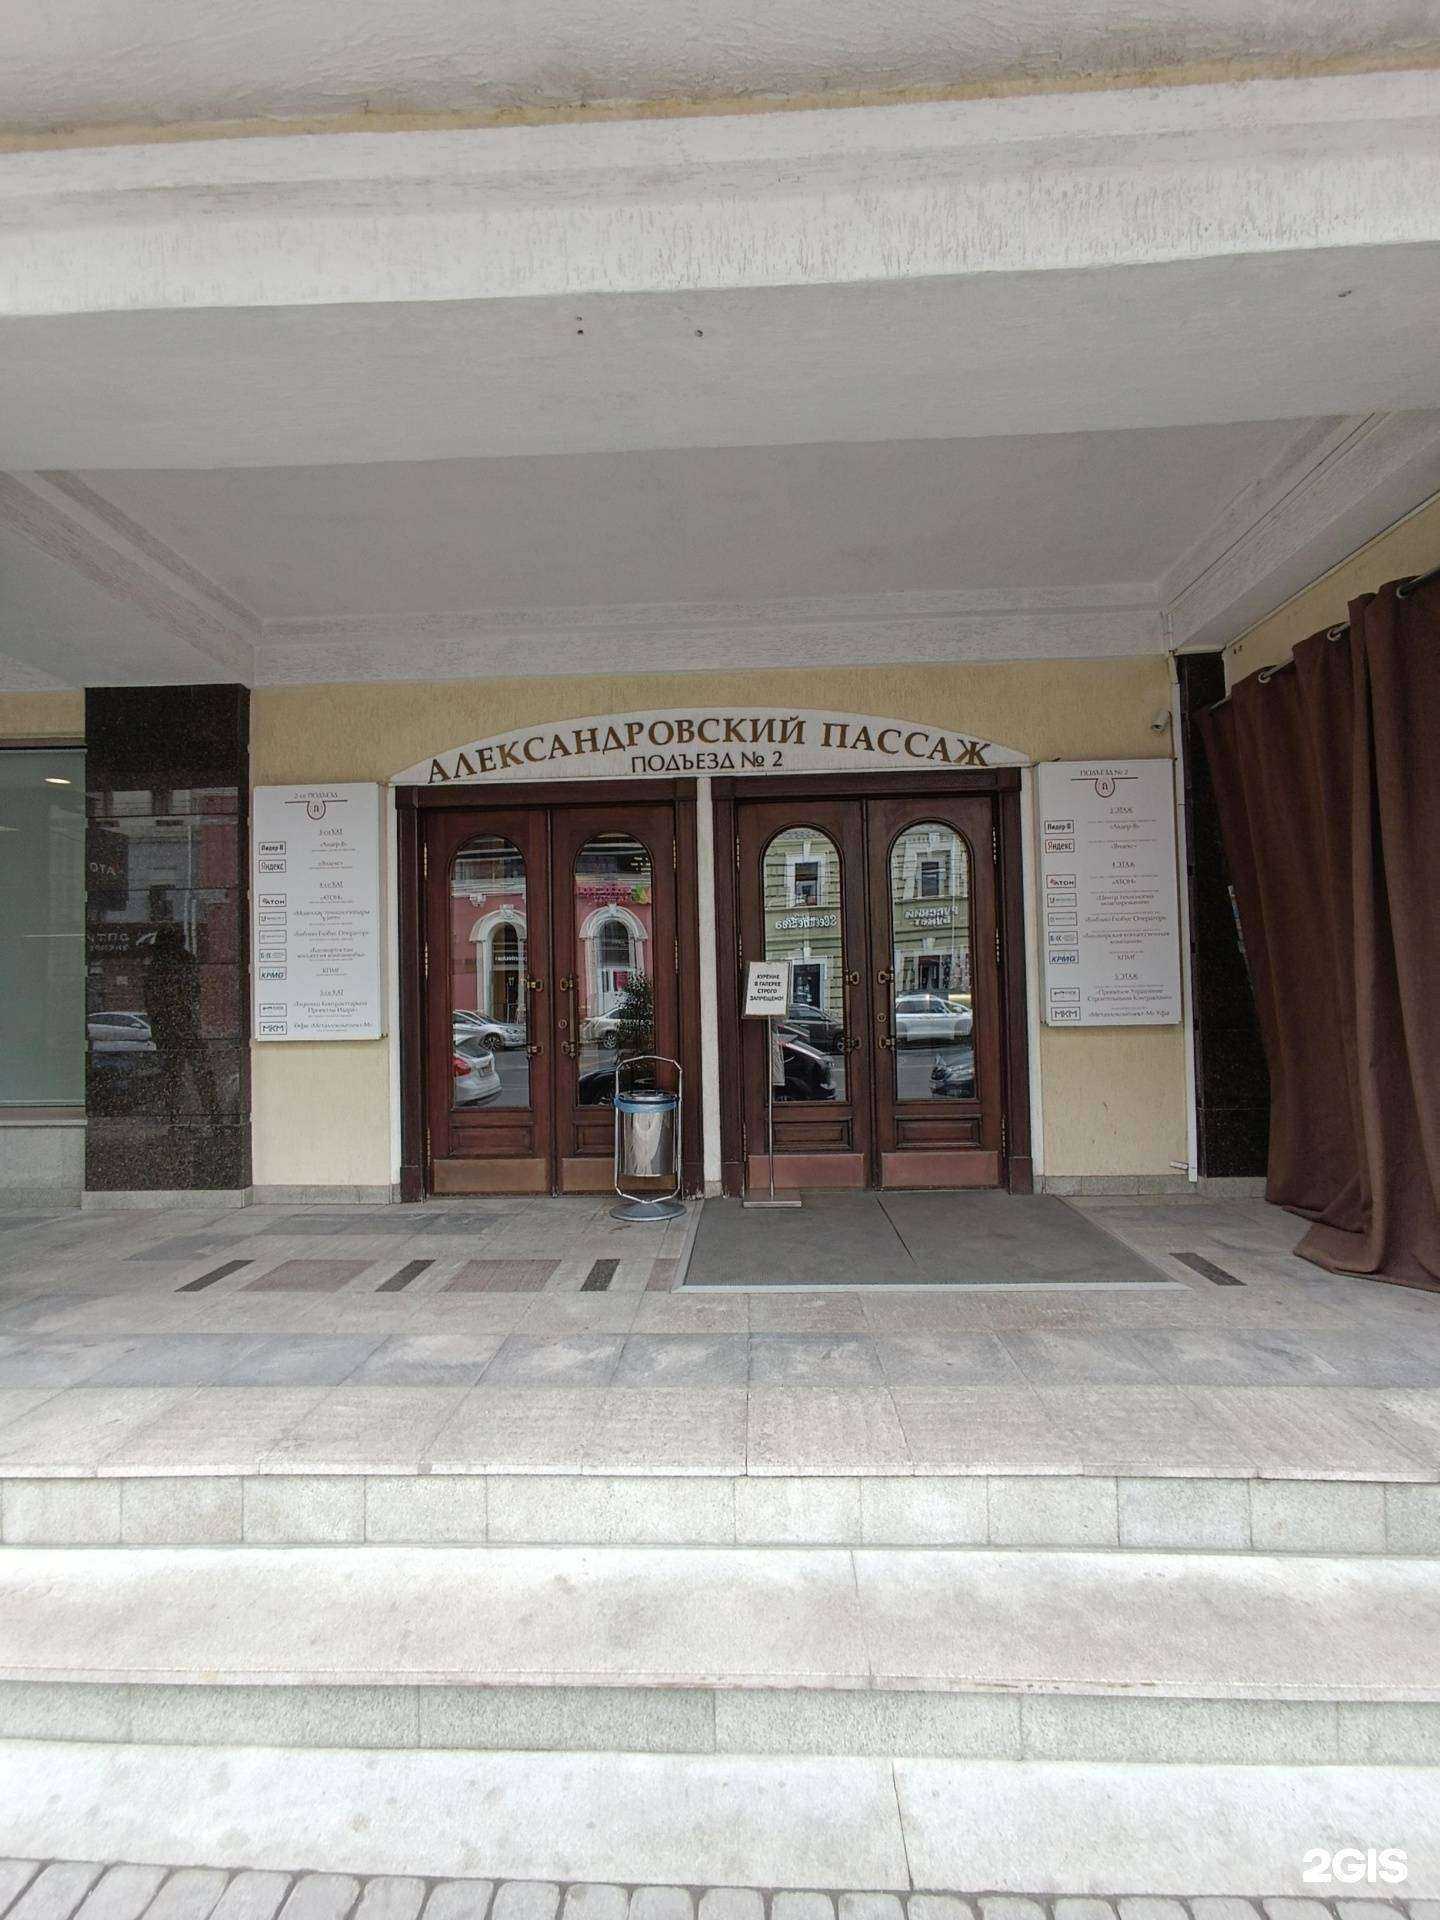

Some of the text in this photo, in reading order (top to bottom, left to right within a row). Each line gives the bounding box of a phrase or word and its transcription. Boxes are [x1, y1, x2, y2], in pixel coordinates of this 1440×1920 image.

[427, 715, 991, 784] АЛЕКСАНДРОВСКИЙ ПАССАЖ
[631, 751, 783, 773] ПОДЪЕЗД № 2
[1047, 841, 1072, 850] Яндекс
[1051, 954, 1076, 963] KPMG
